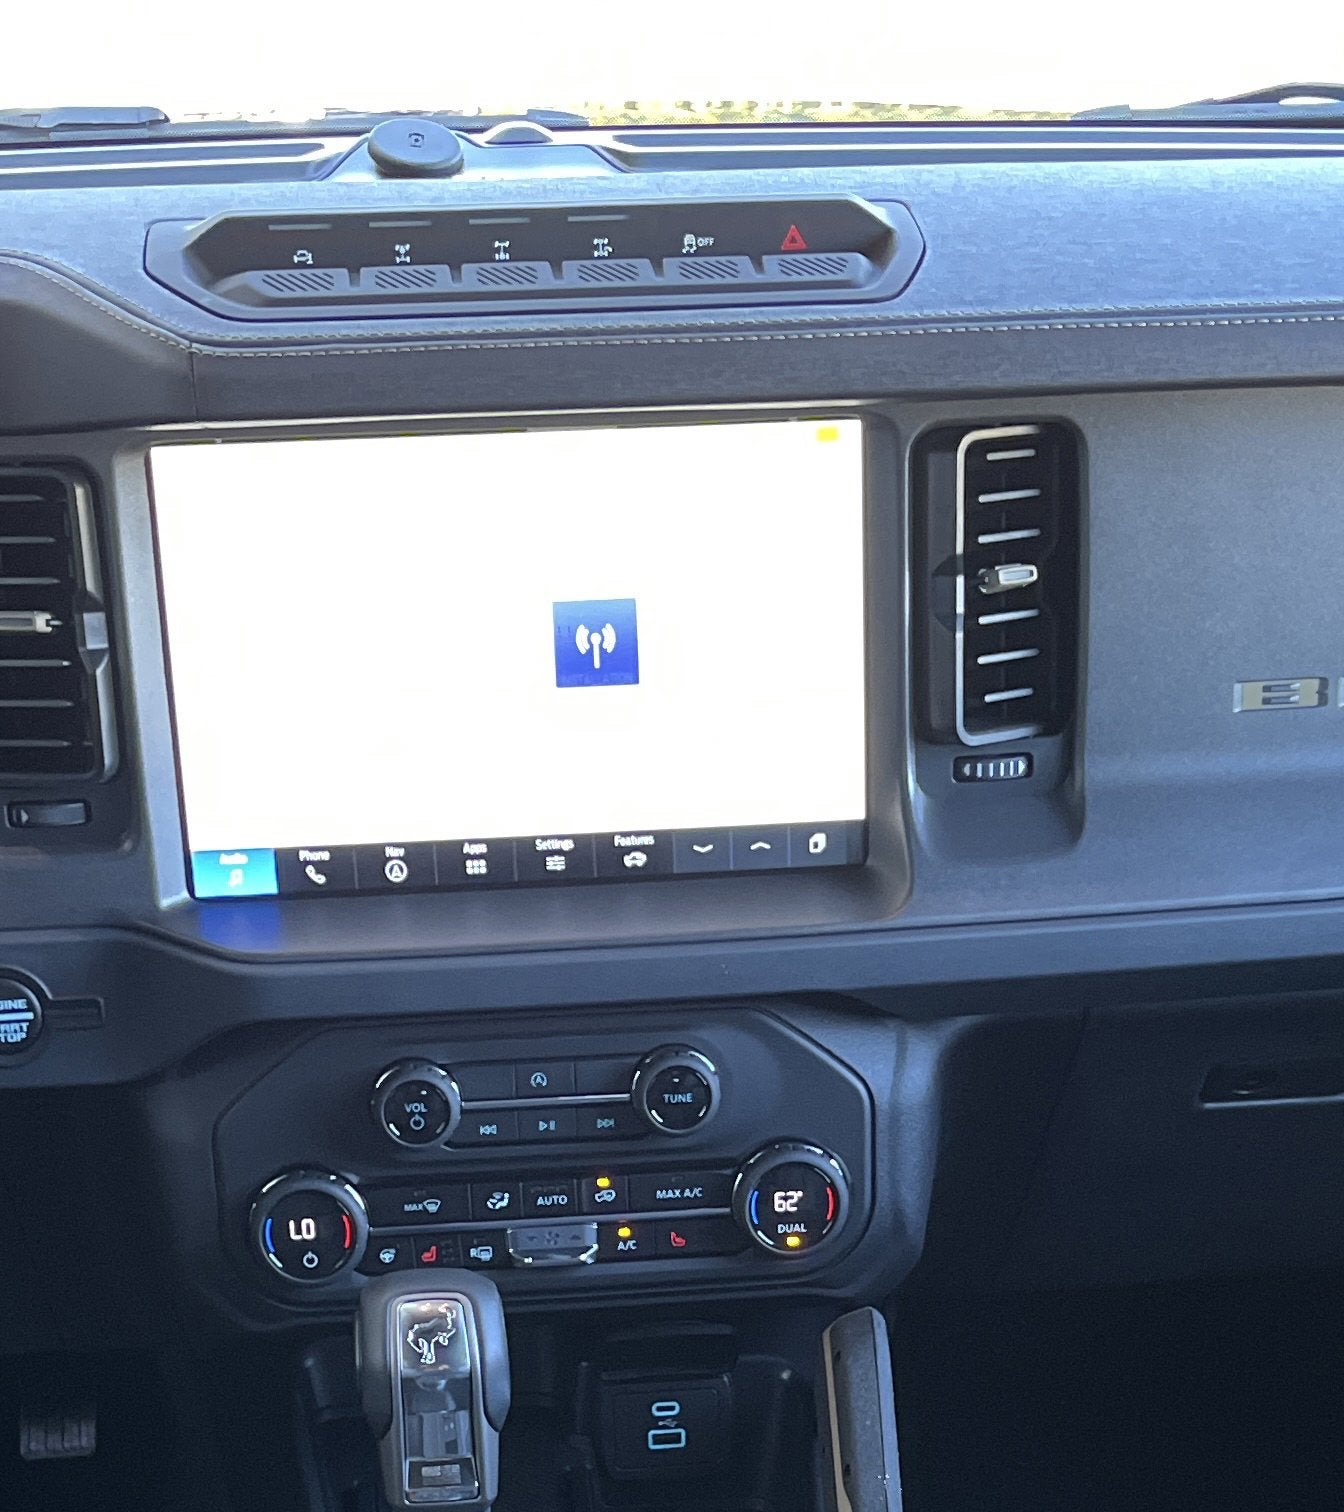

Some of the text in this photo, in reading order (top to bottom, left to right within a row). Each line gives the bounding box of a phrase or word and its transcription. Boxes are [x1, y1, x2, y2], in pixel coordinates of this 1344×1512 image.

[696, 236, 715, 248] OFF
[535, 838, 575, 851] Settings
[613, 834, 655, 847] Features
[299, 849, 331, 862] Phone
[384, 845, 406, 858] Nav
[662, 1092, 694, 1104] TUNE
[404, 1103, 428, 1113] VOL
[656, 1187, 703, 1200] MAX A/C
[536, 1196, 568, 1206] AUTO
[403, 1203, 423, 1213] MAX
[288, 1217, 317, 1241] LO
[777, 1223, 808, 1234] DUAL
[617, 1240, 638, 1251] A/C
